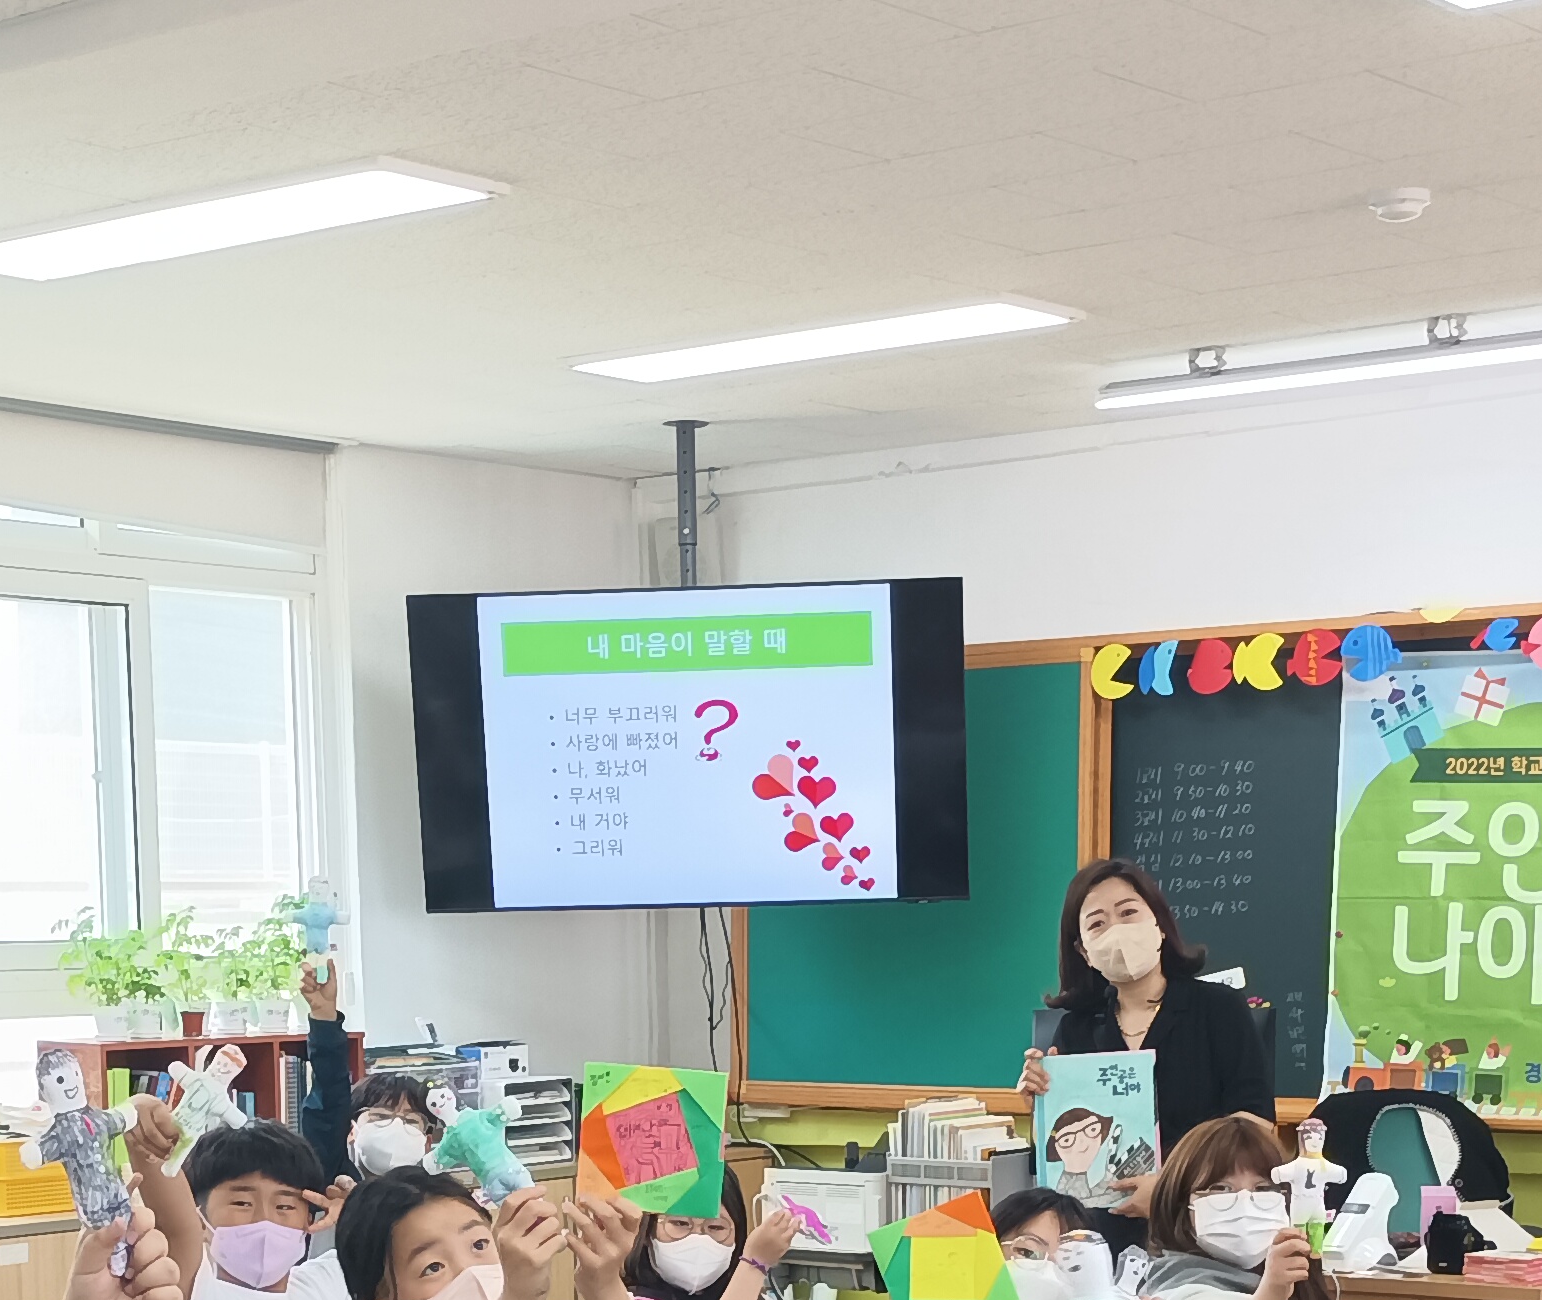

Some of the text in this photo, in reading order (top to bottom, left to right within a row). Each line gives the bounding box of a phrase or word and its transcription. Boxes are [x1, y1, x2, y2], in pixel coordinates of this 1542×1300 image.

[587, 628, 786, 659] 내 마음이 말할 때
[565, 707, 599, 725] 너무
[607, 705, 677, 724] 부끄러워
[566, 731, 678, 752] 사랑에 빠졌어
[567, 759, 647, 779] 나, 화났어
[1445, 755, 1505, 776] 2022년
[569, 786, 620, 804] 무서워
[570, 812, 629, 831] 내 거야
[572, 839, 623, 857] 그리워
[1096, 1064, 1137, 1086] 주인공은
[1112, 1082, 1141, 1097] 너야
